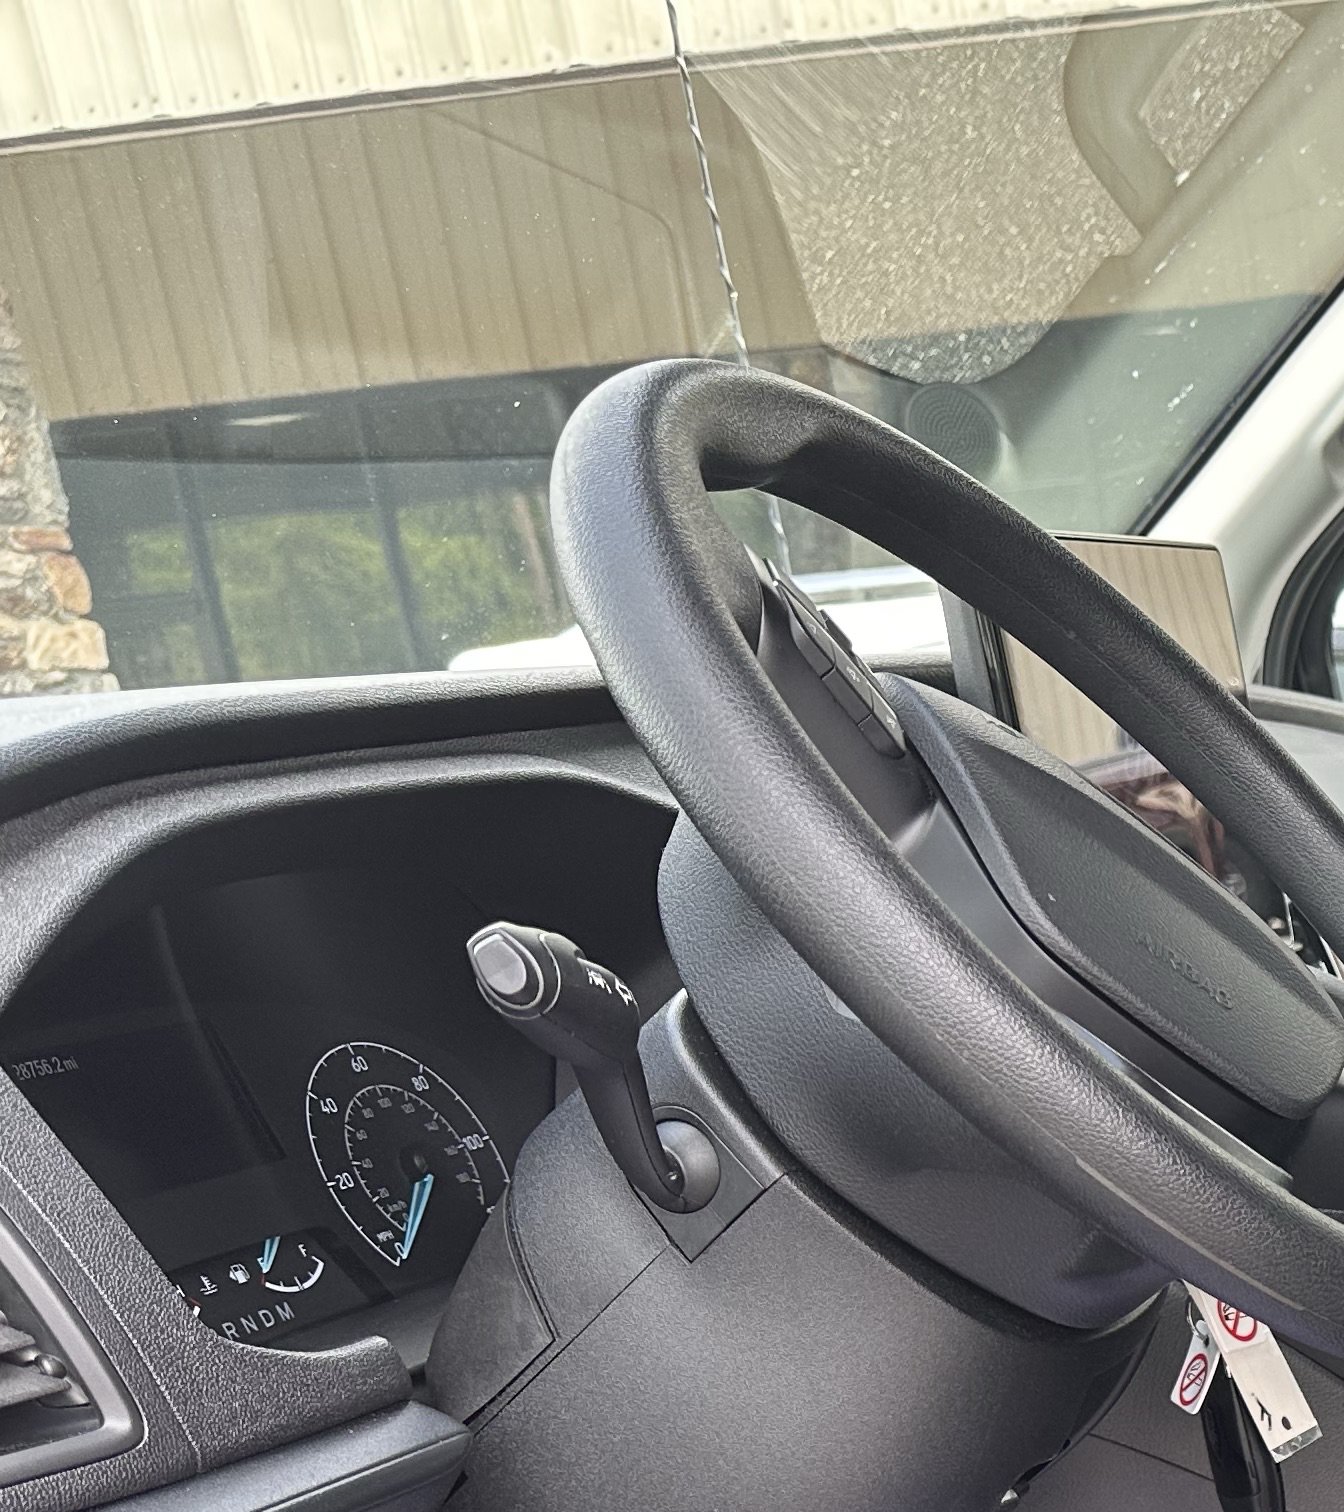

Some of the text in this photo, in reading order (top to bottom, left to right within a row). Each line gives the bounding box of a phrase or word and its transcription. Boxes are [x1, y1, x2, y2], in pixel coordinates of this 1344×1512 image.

[351, 1055, 369, 1072] 60
[411, 1075, 430, 1092] 80
[320, 1097, 338, 1114] 40
[461, 1133, 485, 1150] 100
[335, 1172, 355, 1190] 20
[298, 1243, 307, 1258] F
